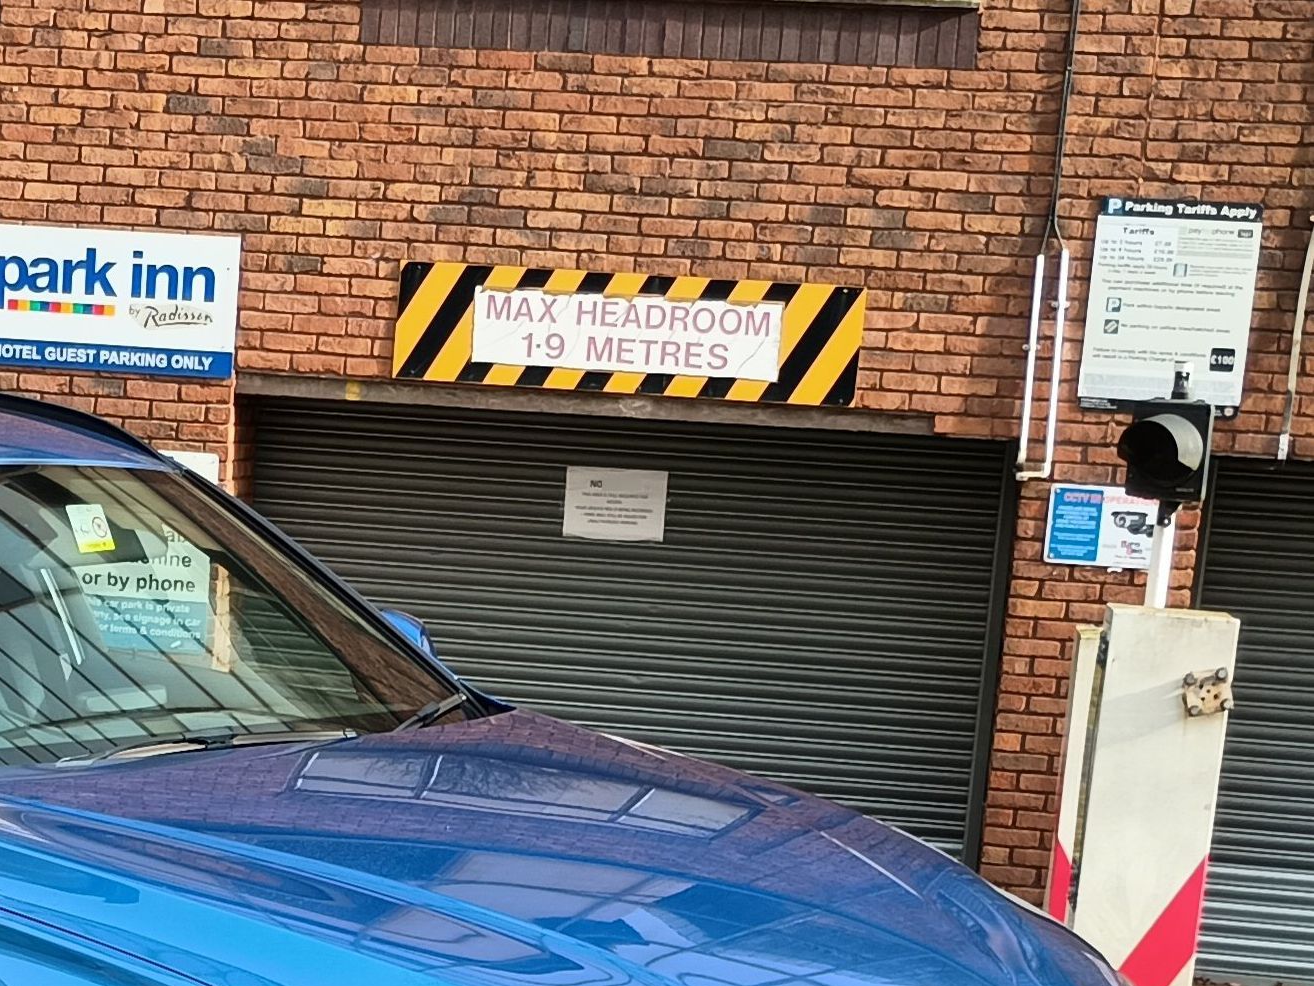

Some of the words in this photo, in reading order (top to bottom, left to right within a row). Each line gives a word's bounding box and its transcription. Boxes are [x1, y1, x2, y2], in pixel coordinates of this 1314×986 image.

[1124, 201, 1173, 216] Parking
[1177, 203, 1218, 217] Tariffs
[1220, 205, 1257, 219] Apply
[130, 250, 216, 303] inn
[128, 304, 141, 319] by
[143, 303, 214, 329] Radisson
[485, 294, 559, 325] MAX
[575, 300, 772, 338] HEADROOM
[44, 345, 98, 364] GUEST
[99, 349, 168, 369] PARKING
[170, 353, 215, 372] ONLY
[585, 336, 730, 371] METRES
[1210, 354, 1236, 366] £100
[590, 480, 603, 489] NO
[82, 572, 103, 586] or
[107, 571, 130, 592] by
[136, 573, 196, 593] phone
[121, 599, 143, 610] park
[133, 612, 171, 625] signage
[185, 618, 201, 627] car
[140, 625, 148, 635] &
